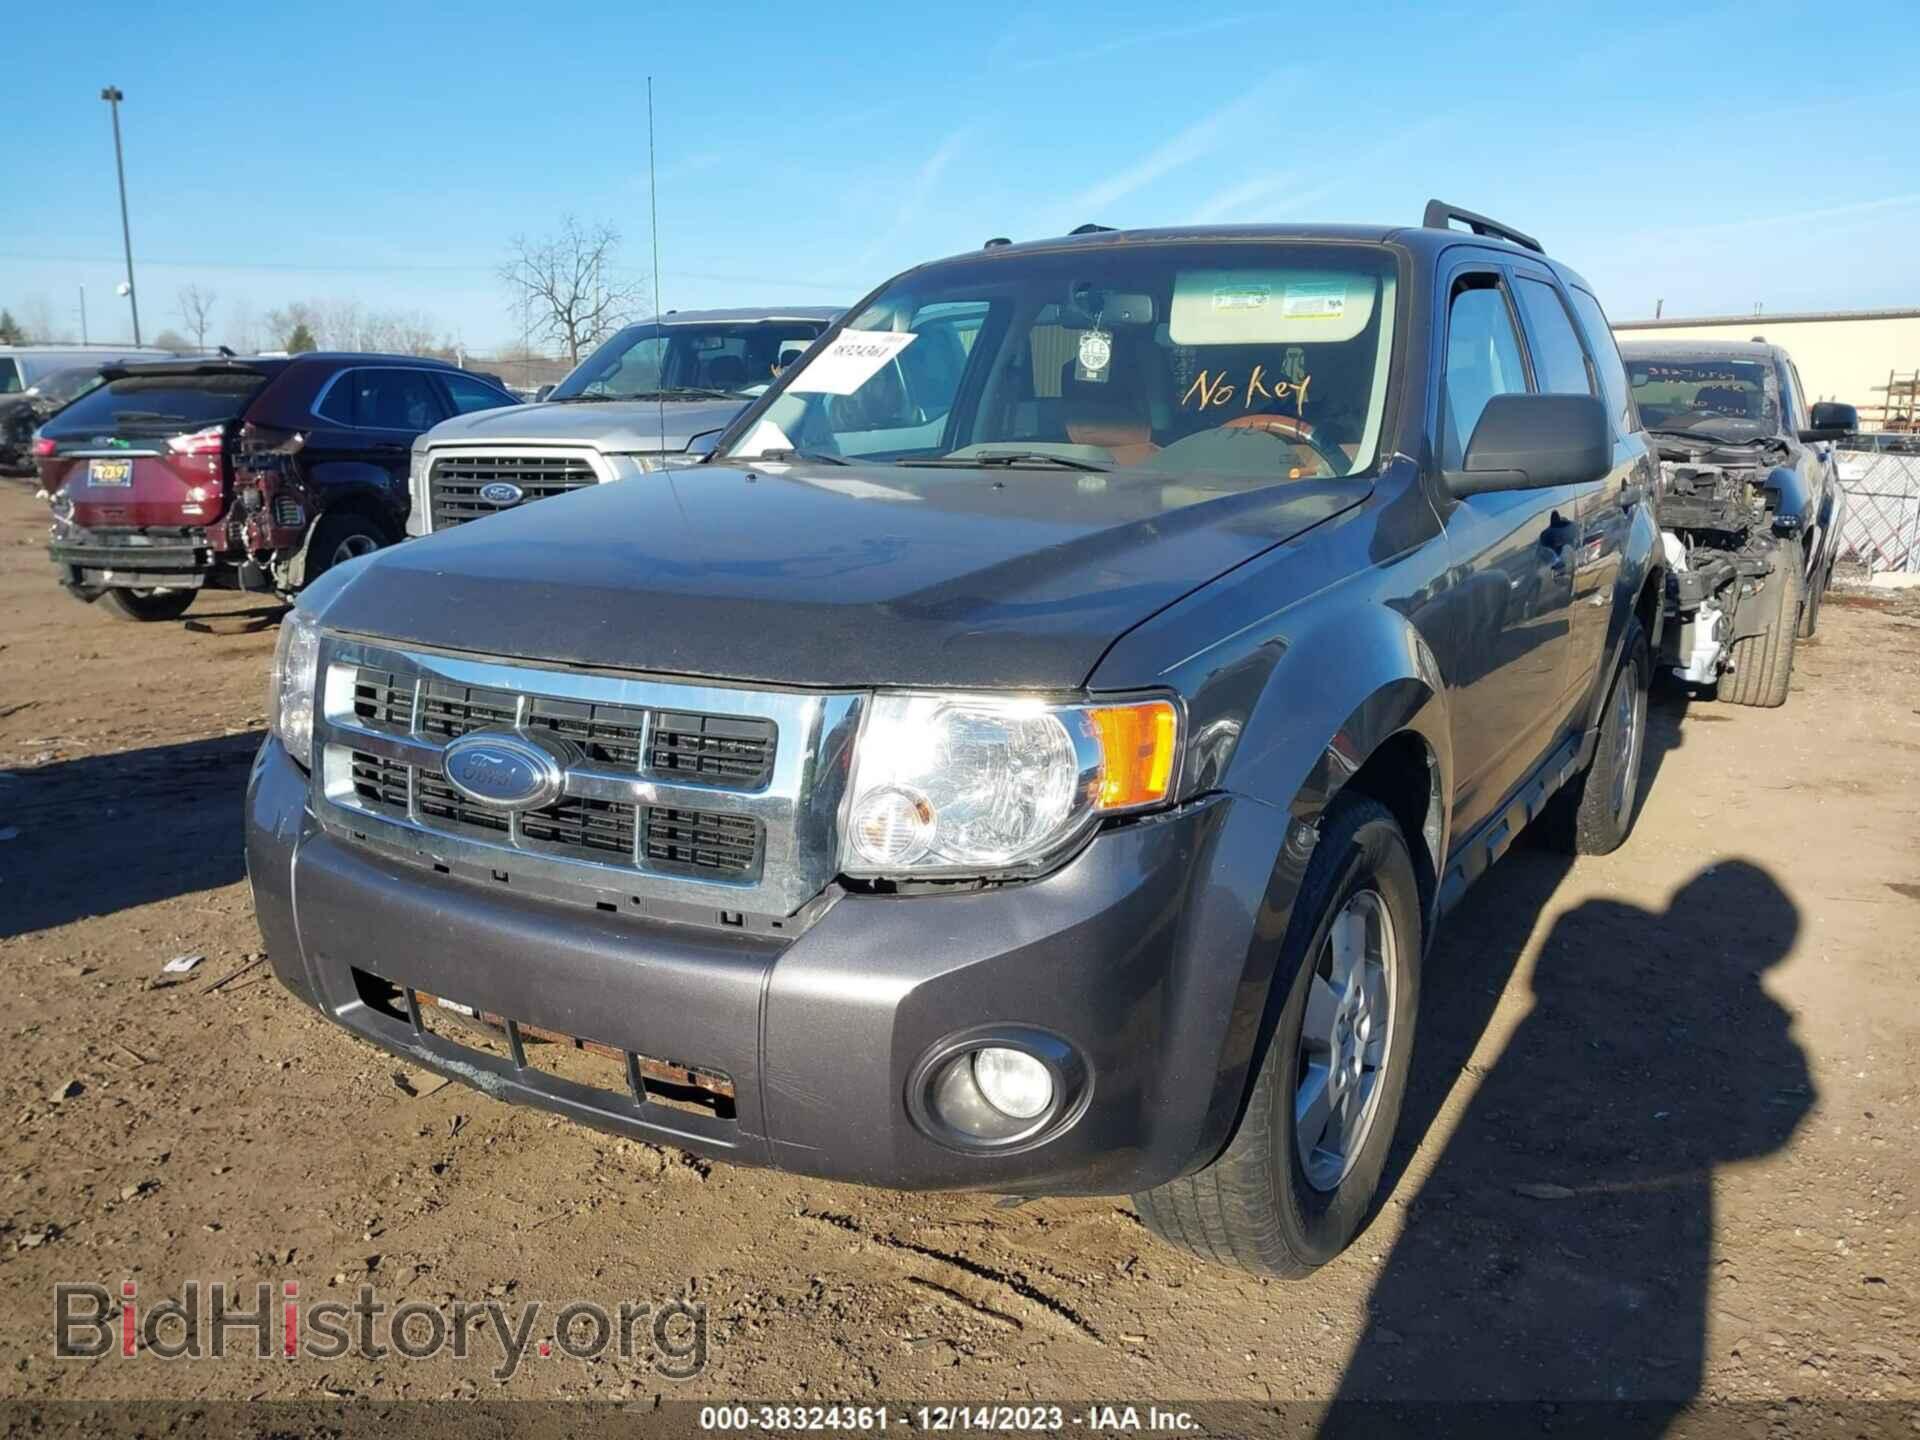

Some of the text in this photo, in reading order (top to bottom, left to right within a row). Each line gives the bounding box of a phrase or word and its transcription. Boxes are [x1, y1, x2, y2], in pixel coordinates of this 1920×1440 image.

[1182, 365, 1311, 416] No Key
[463, 753, 516, 785] Ford
